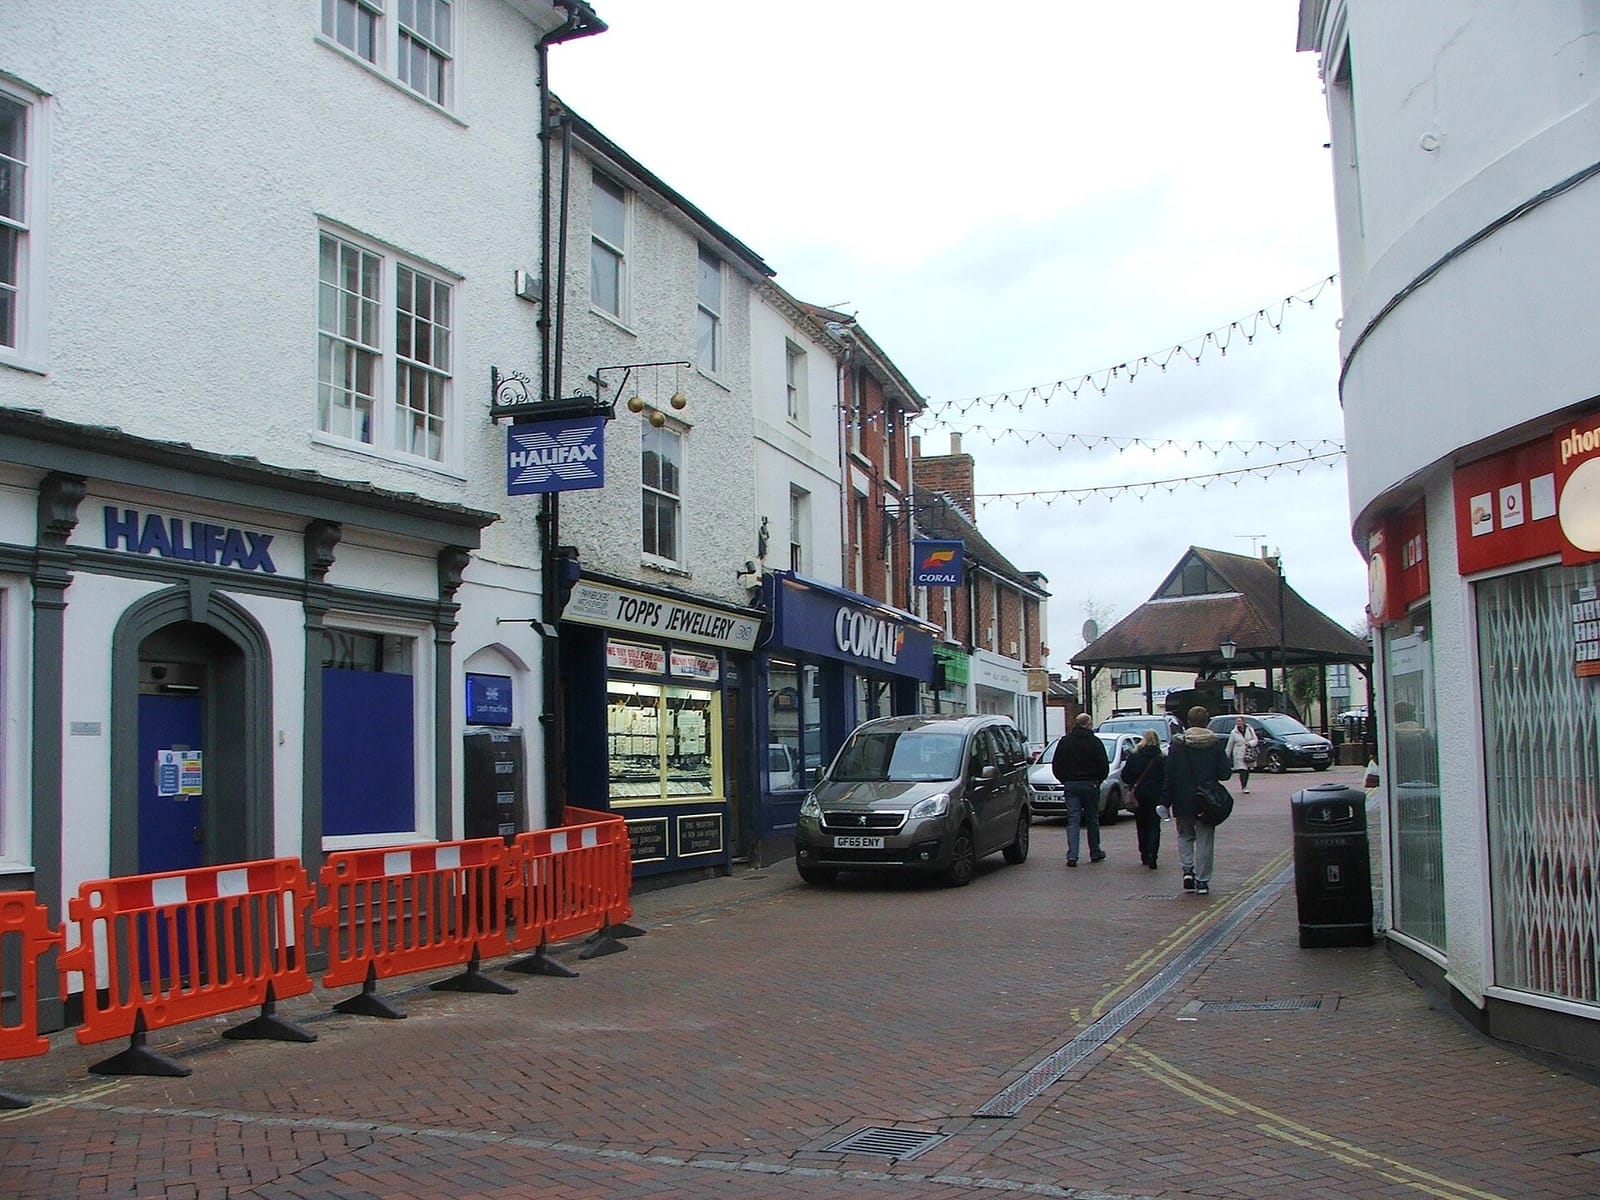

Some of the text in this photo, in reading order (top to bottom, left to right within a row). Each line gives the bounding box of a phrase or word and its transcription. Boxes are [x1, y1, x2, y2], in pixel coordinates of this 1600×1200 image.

[510, 444, 598, 468] HALIFAX
[104, 505, 277, 573] HALIFAX
[918, 574, 956, 582] CORAL
[616, 595, 736, 641] TOPPS JEWELLERY
[835, 606, 897, 665] CORAL
[640, 651, 654, 661] FOR
[837, 837, 880, 847] GF65 ENY
